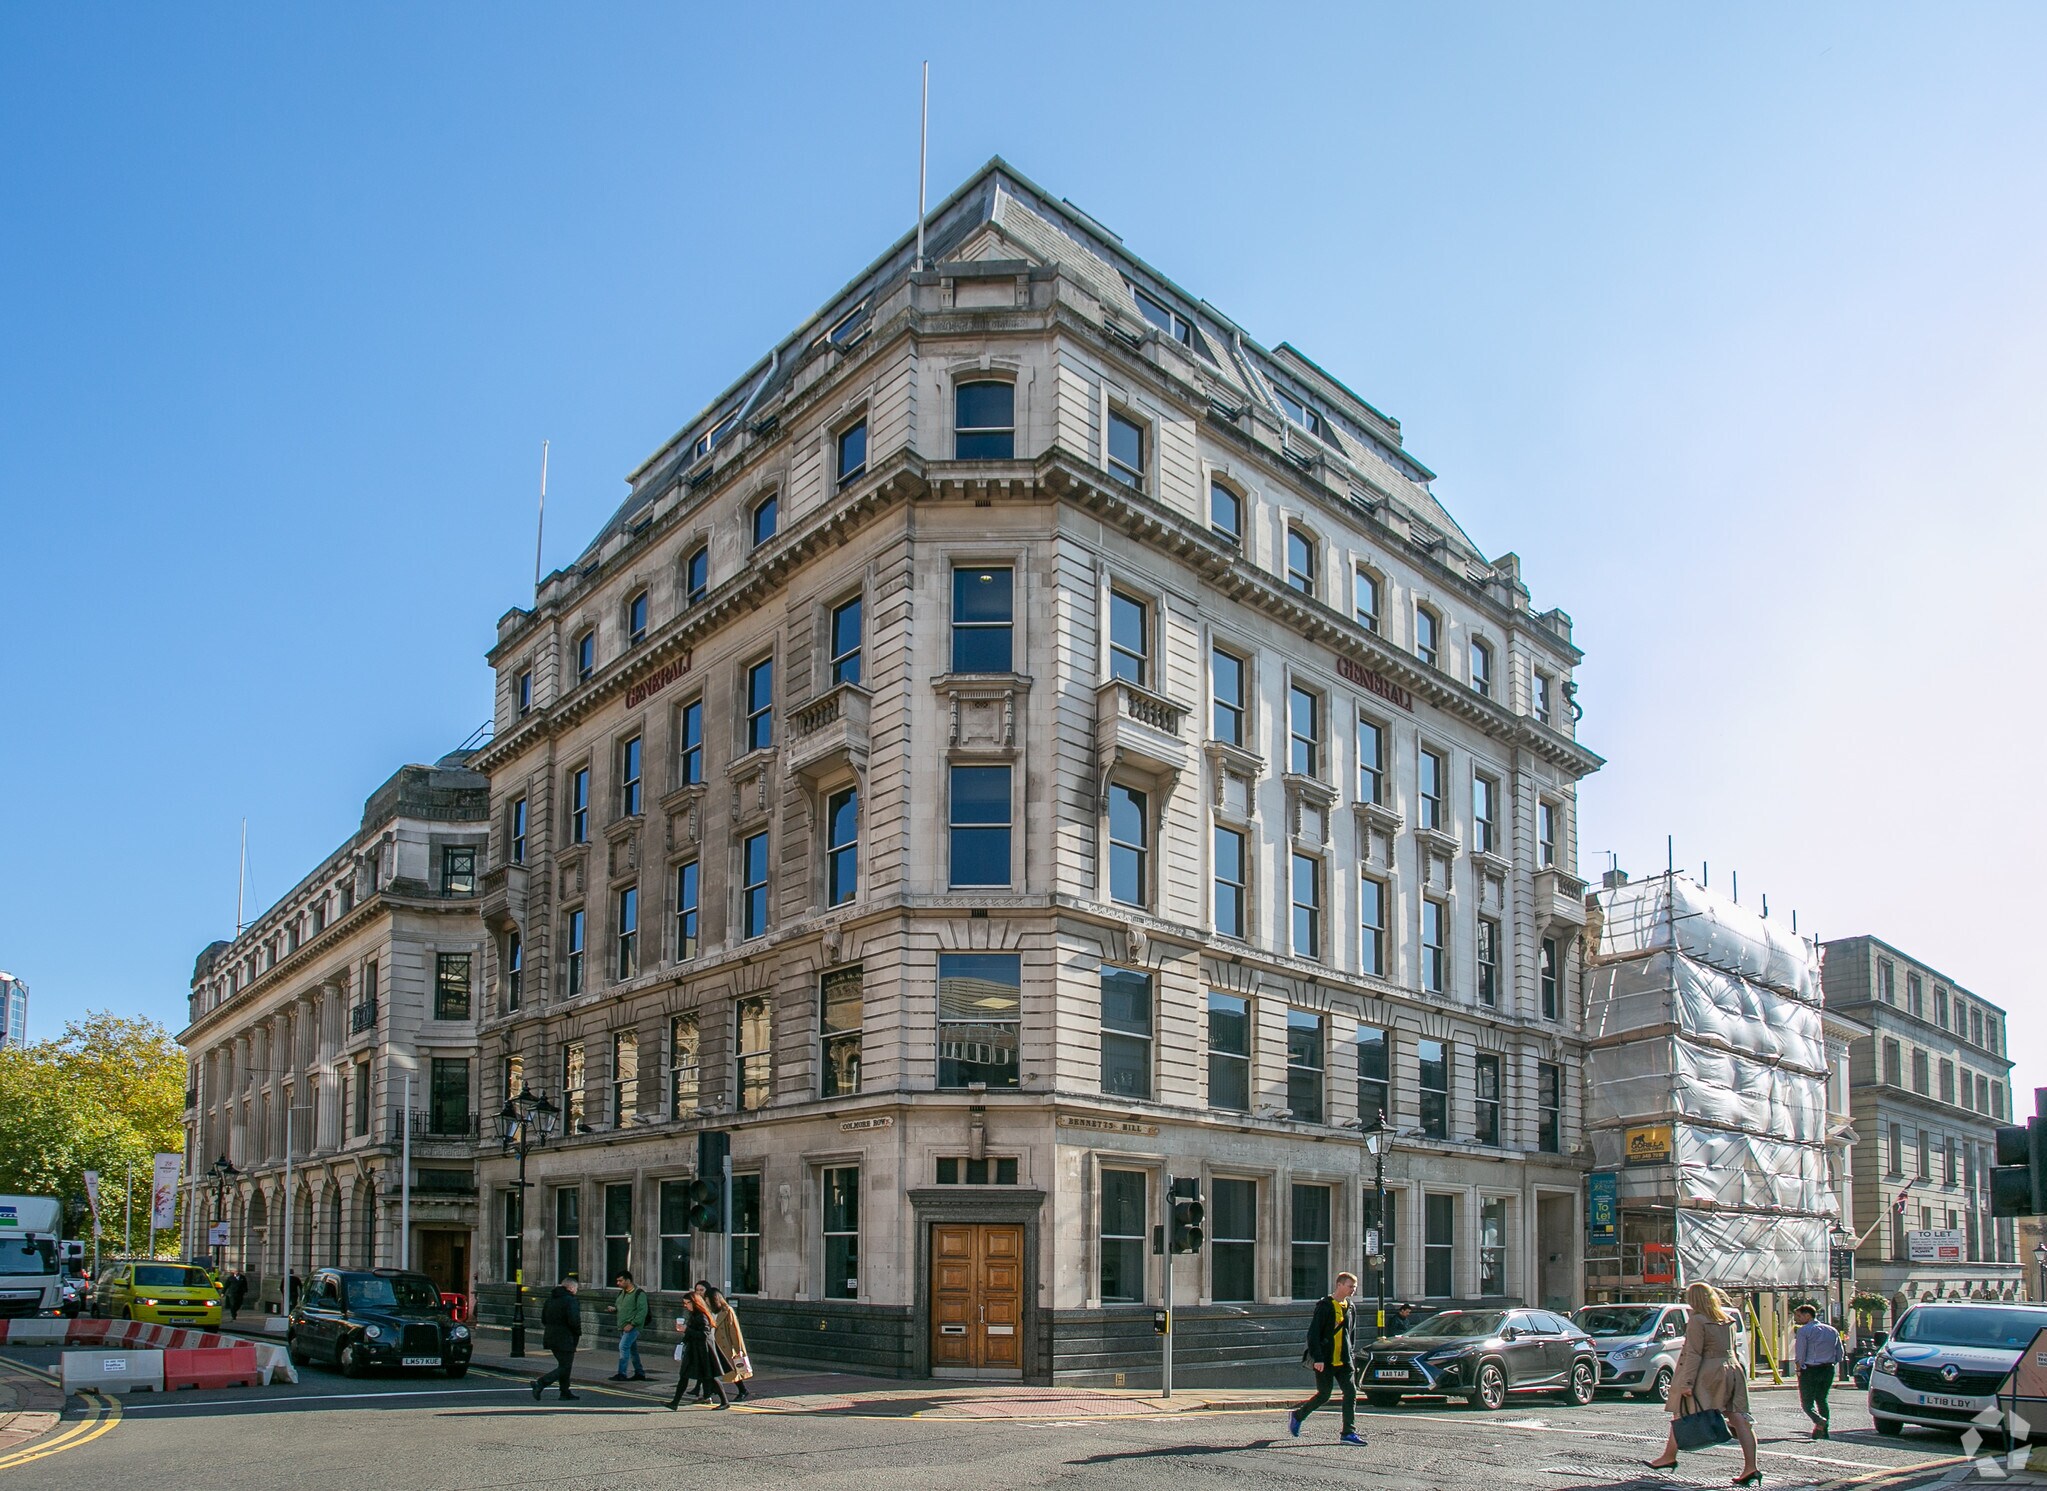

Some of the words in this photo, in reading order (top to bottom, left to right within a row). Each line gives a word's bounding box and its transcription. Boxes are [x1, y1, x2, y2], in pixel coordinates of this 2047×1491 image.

[626, 647, 692, 709] GENERALI
[1337, 657, 1414, 713] GENERALI
[1068, 1118, 1114, 1129] BENNETTS
[1122, 1123, 1142, 1132] HILL
[1598, 1203, 1609, 1211] To
[1596, 1211, 1611, 1220] Let
[1927, 1396, 1948, 1406] LT18
[1951, 1398, 1970, 1408] LDY
